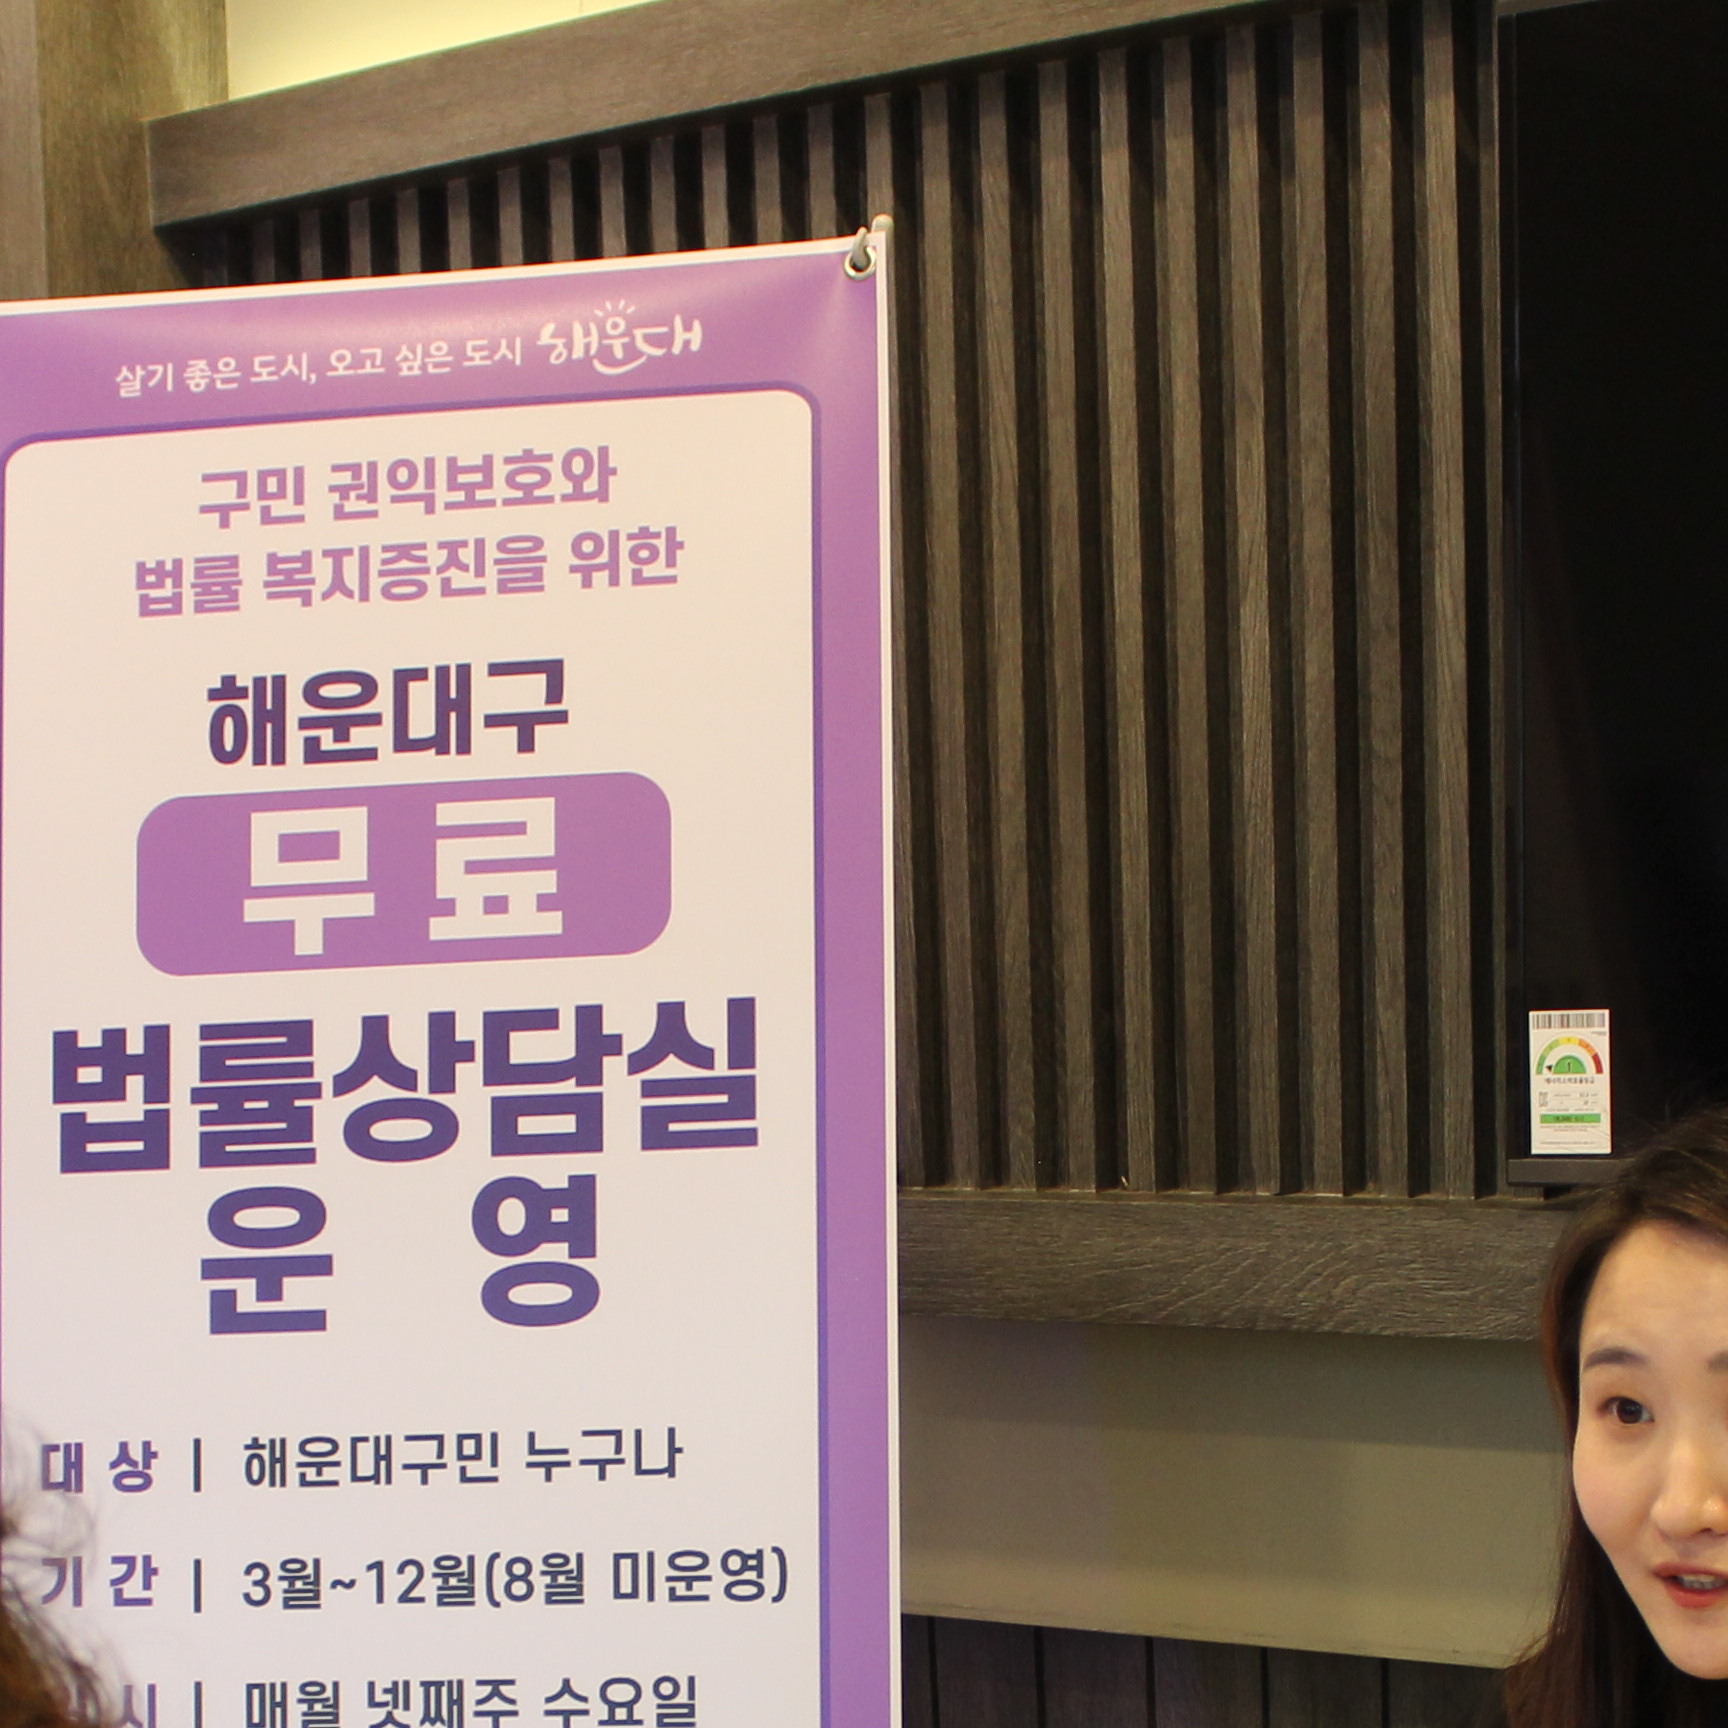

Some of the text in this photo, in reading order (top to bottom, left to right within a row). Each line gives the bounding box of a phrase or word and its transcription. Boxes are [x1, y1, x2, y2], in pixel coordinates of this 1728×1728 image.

[115, 312, 702, 398] 살기 좋은 도시, 오고 싶은 도시 해운대
[198, 444, 618, 529] 구민 권익보호와
[134, 525, 685, 619] 법률 복지증진을 위한
[207, 657, 570, 768] 해운대구
[243, 796, 565, 956] 무 료
[50, 996, 761, 1174] 법률상담실
[200, 1173, 602, 1336] 운 영
[39, 1426, 684, 1496] 대 상 해운대구민 누구나
[39, 1545, 789, 1612] 기 간 3월~12월(8월 미운영)
